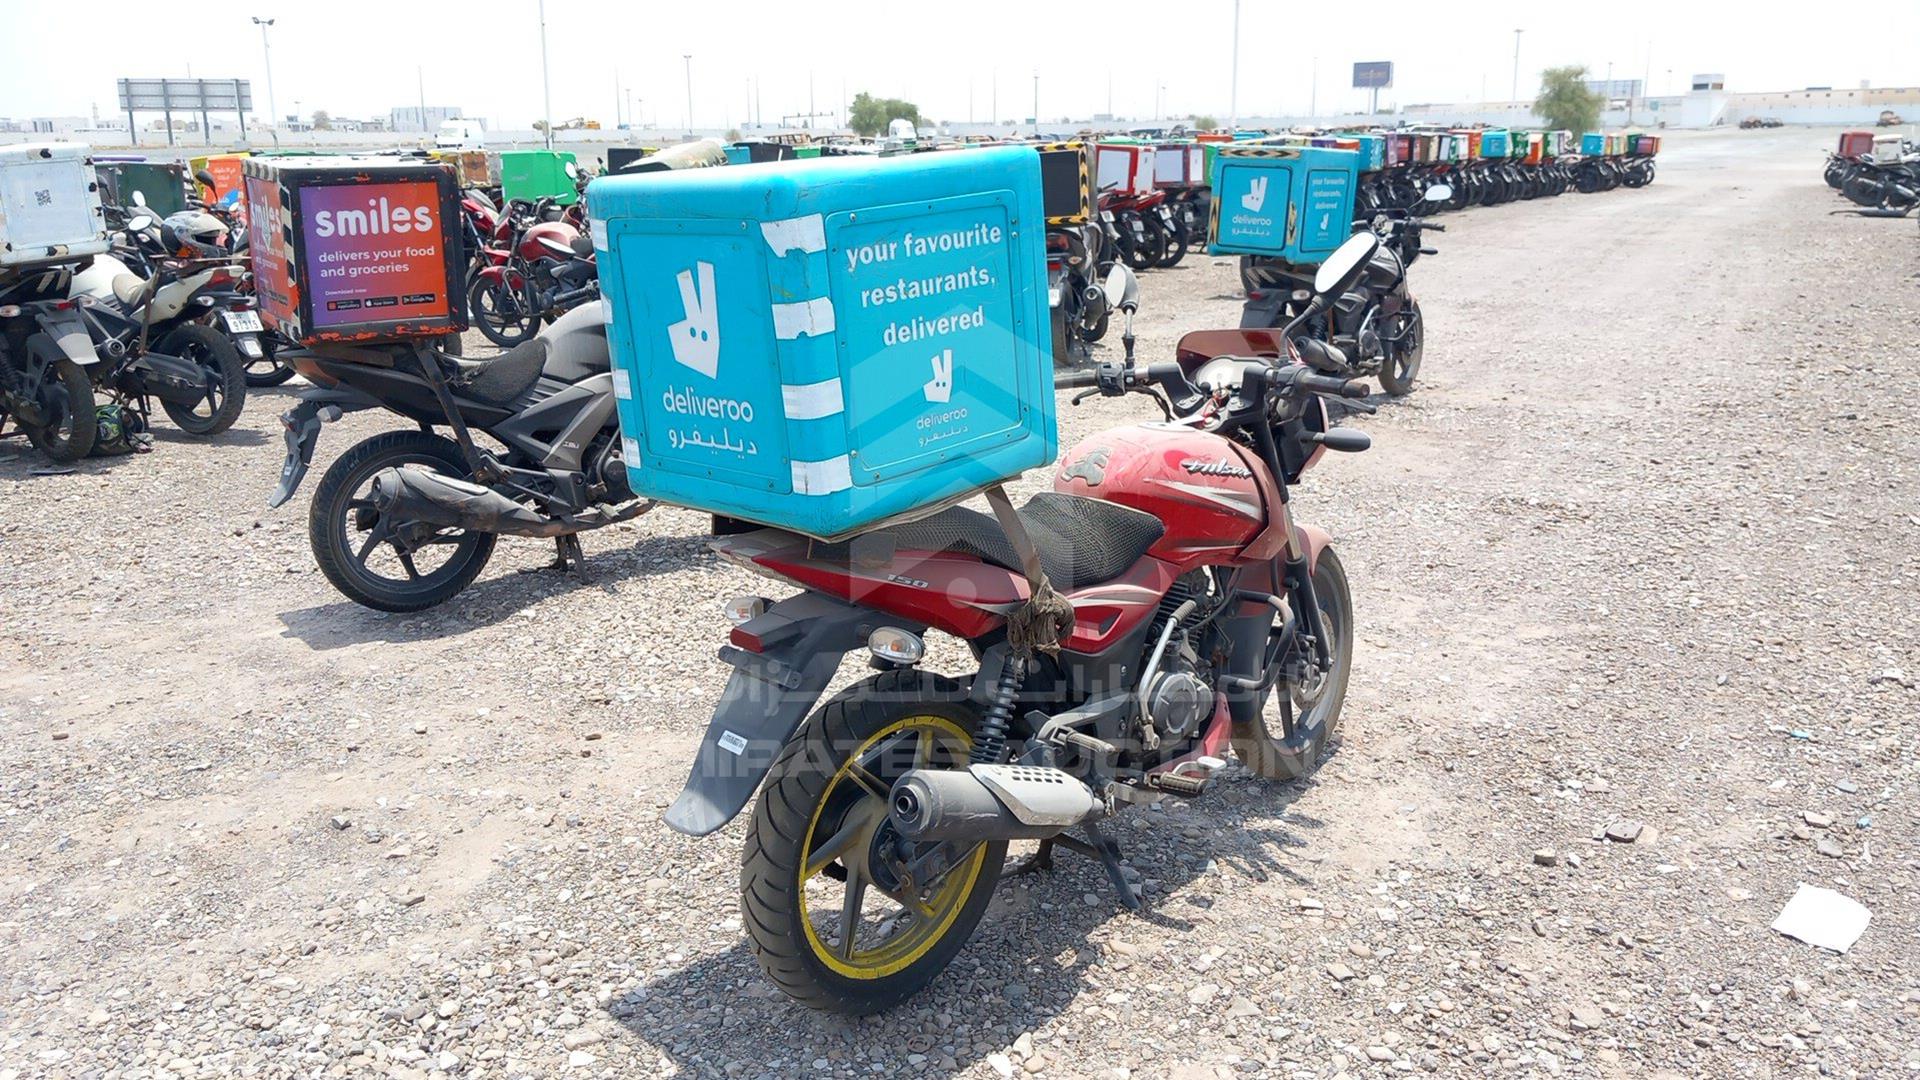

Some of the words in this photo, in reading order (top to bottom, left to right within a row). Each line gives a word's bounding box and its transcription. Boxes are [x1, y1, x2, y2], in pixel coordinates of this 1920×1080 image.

[315, 197, 433, 237] smiles
[1232, 214, 1272, 226] deliveroo
[319, 250, 370, 263] delivers
[373, 250, 402, 262] your
[405, 246, 435, 257] food
[845, 242, 898, 273] your
[903, 223, 1001, 257] favourite
[320, 266, 345, 278] and
[349, 263, 409, 278] groceries
[861, 265, 996, 308] restaurants,
[883, 305, 984, 346] delivered
[663, 384, 754, 423] deliveroo
[916, 408, 968, 430] deliveroo
[668, 424, 757, 459] ديليفرو
[888, 574, 928, 588] 150
